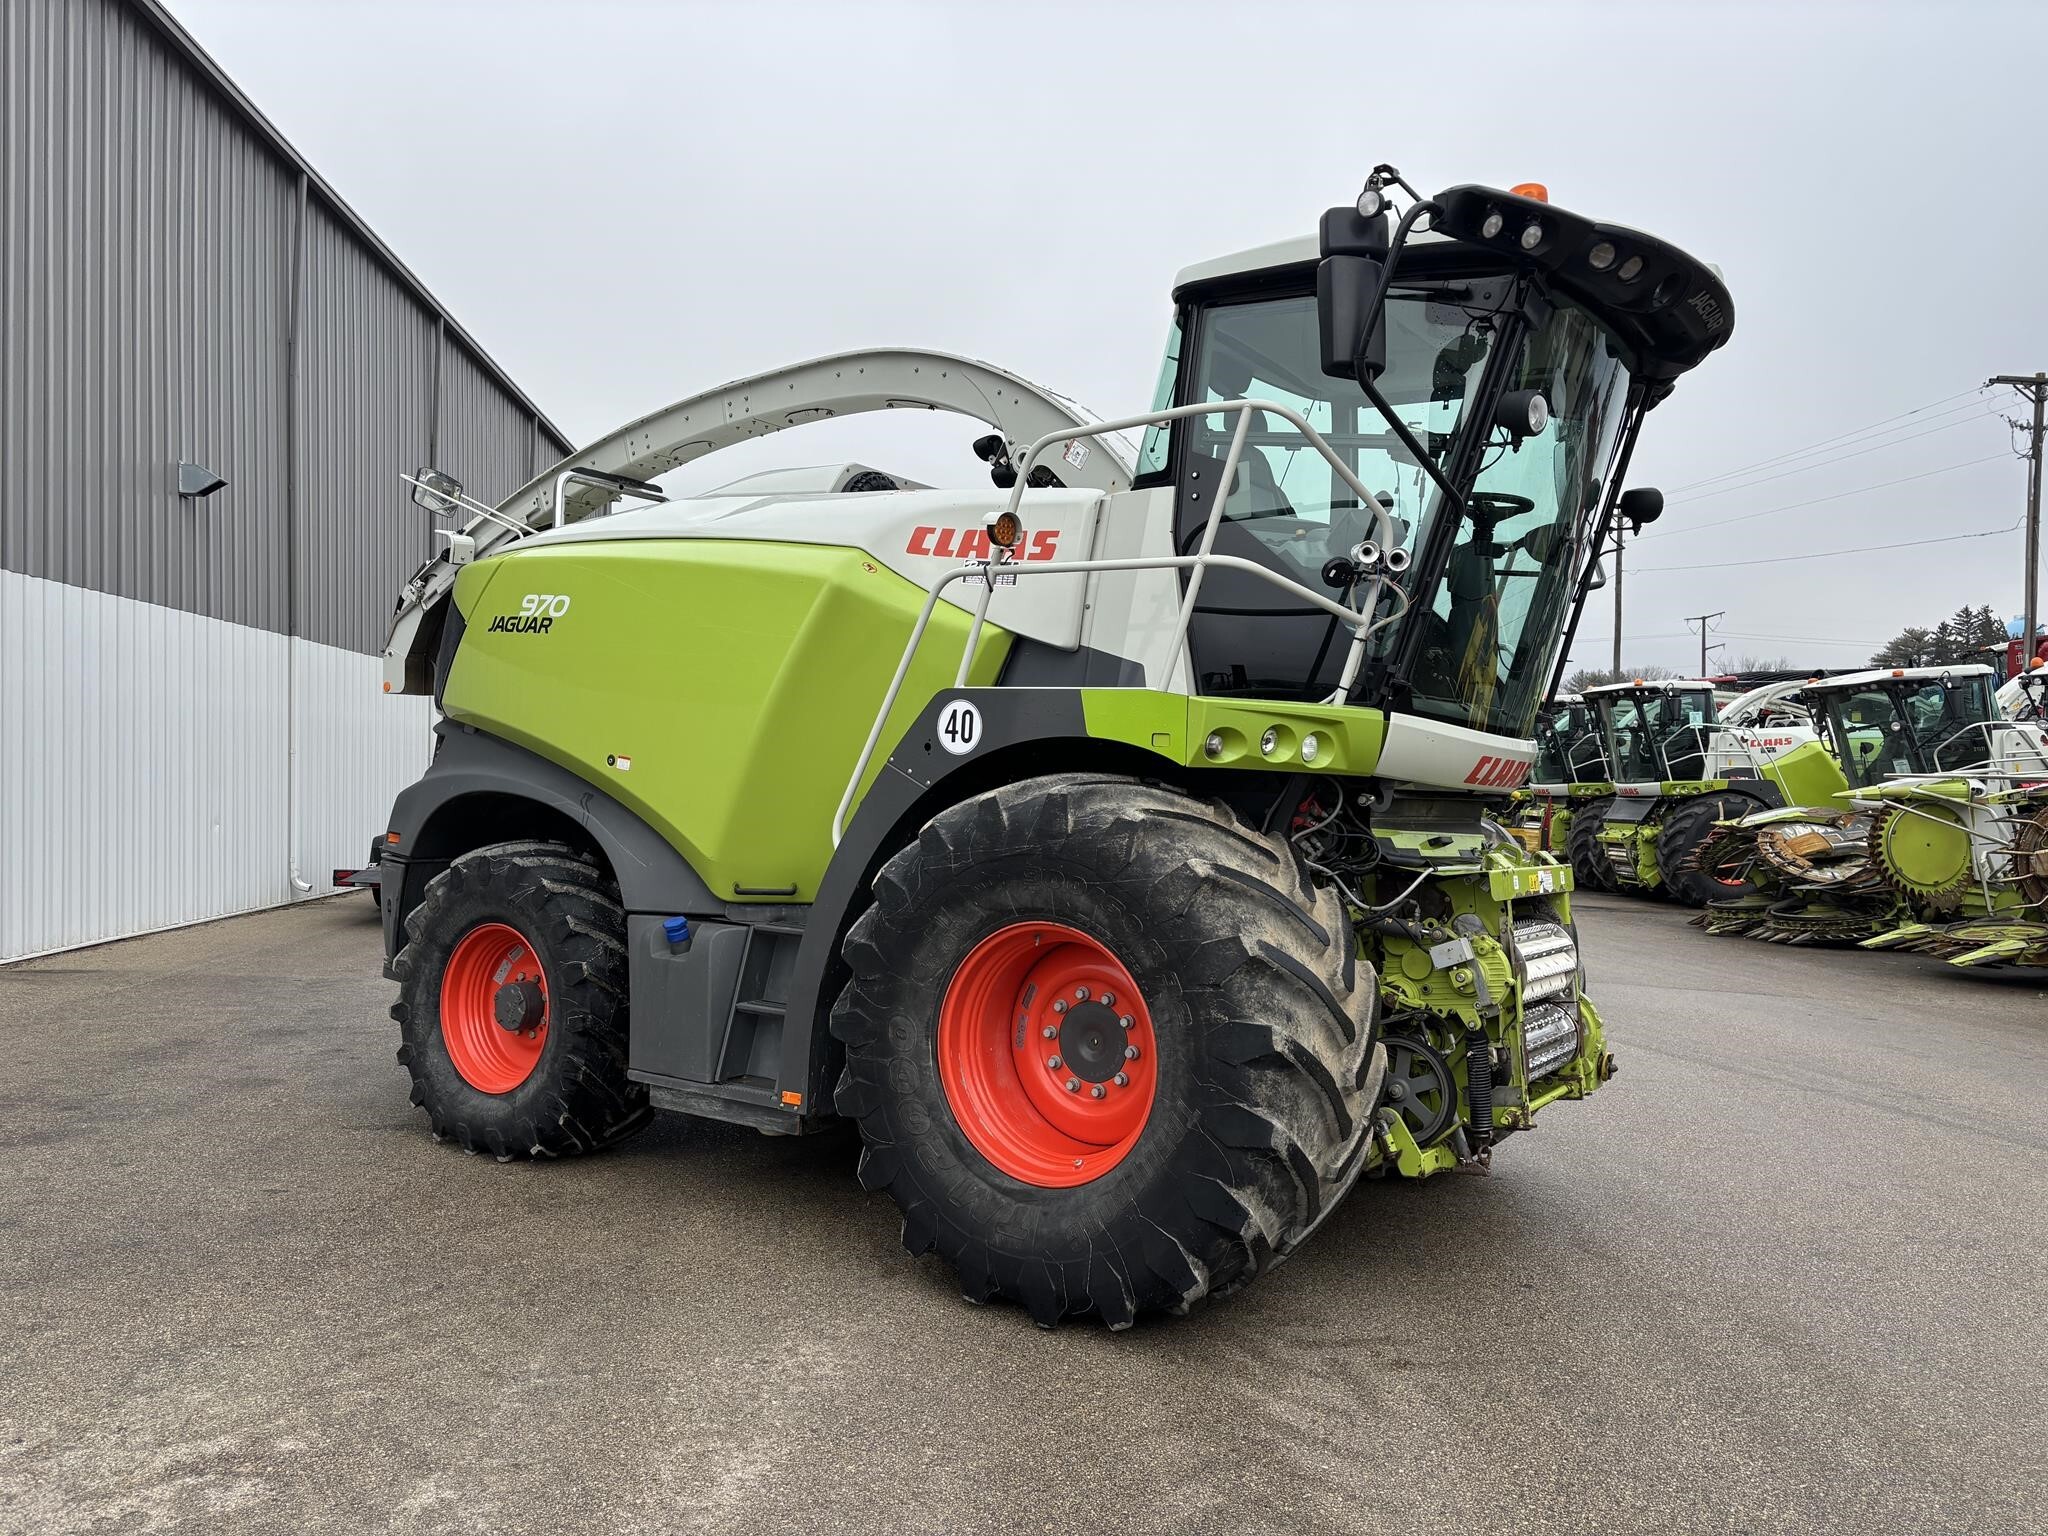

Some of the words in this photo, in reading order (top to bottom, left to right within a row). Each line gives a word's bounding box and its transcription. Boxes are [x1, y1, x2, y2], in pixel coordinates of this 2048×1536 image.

[1687, 290, 1724, 333] JAGUAR
[520, 594, 571, 617] 970
[488, 616, 553, 634] JAGUAR
[945, 709, 974, 743] 40
